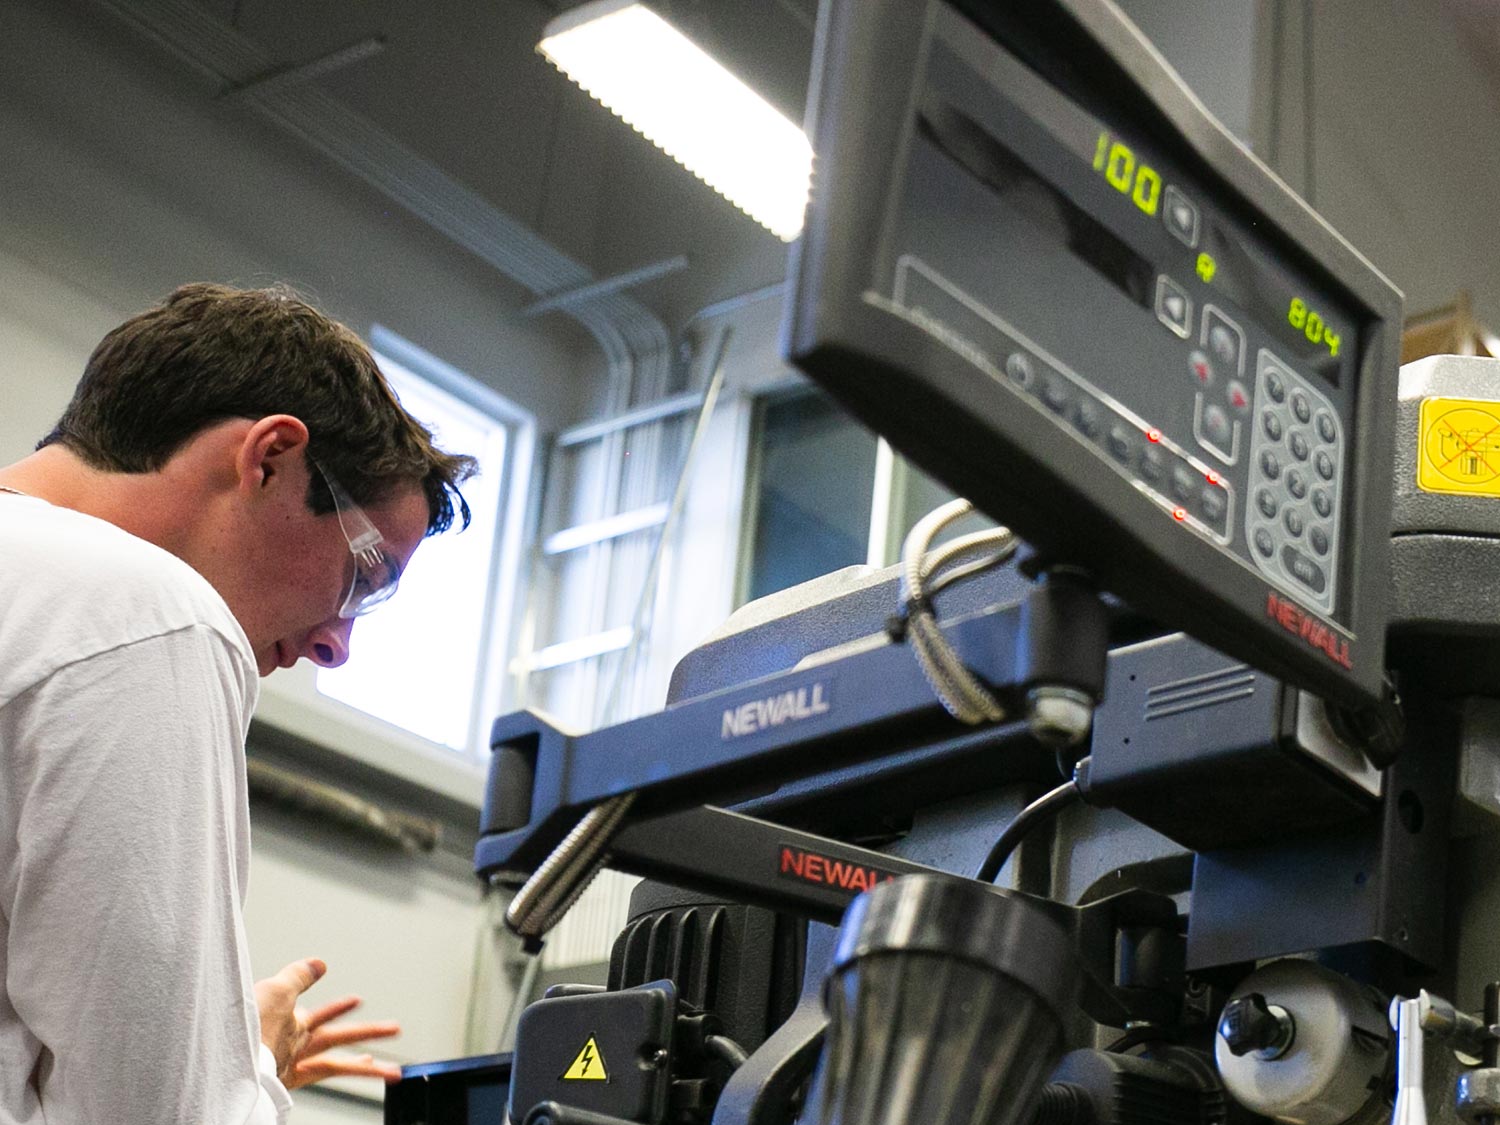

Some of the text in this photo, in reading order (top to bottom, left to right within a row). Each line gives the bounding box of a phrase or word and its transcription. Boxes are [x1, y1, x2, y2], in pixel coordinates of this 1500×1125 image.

[1092, 130, 1162, 217] 100
[1288, 296, 1341, 358] 804
[1267, 591, 1353, 670] NEWALL
[721, 682, 830, 742] NEWALL
[780, 847, 895, 892] NEWAL
